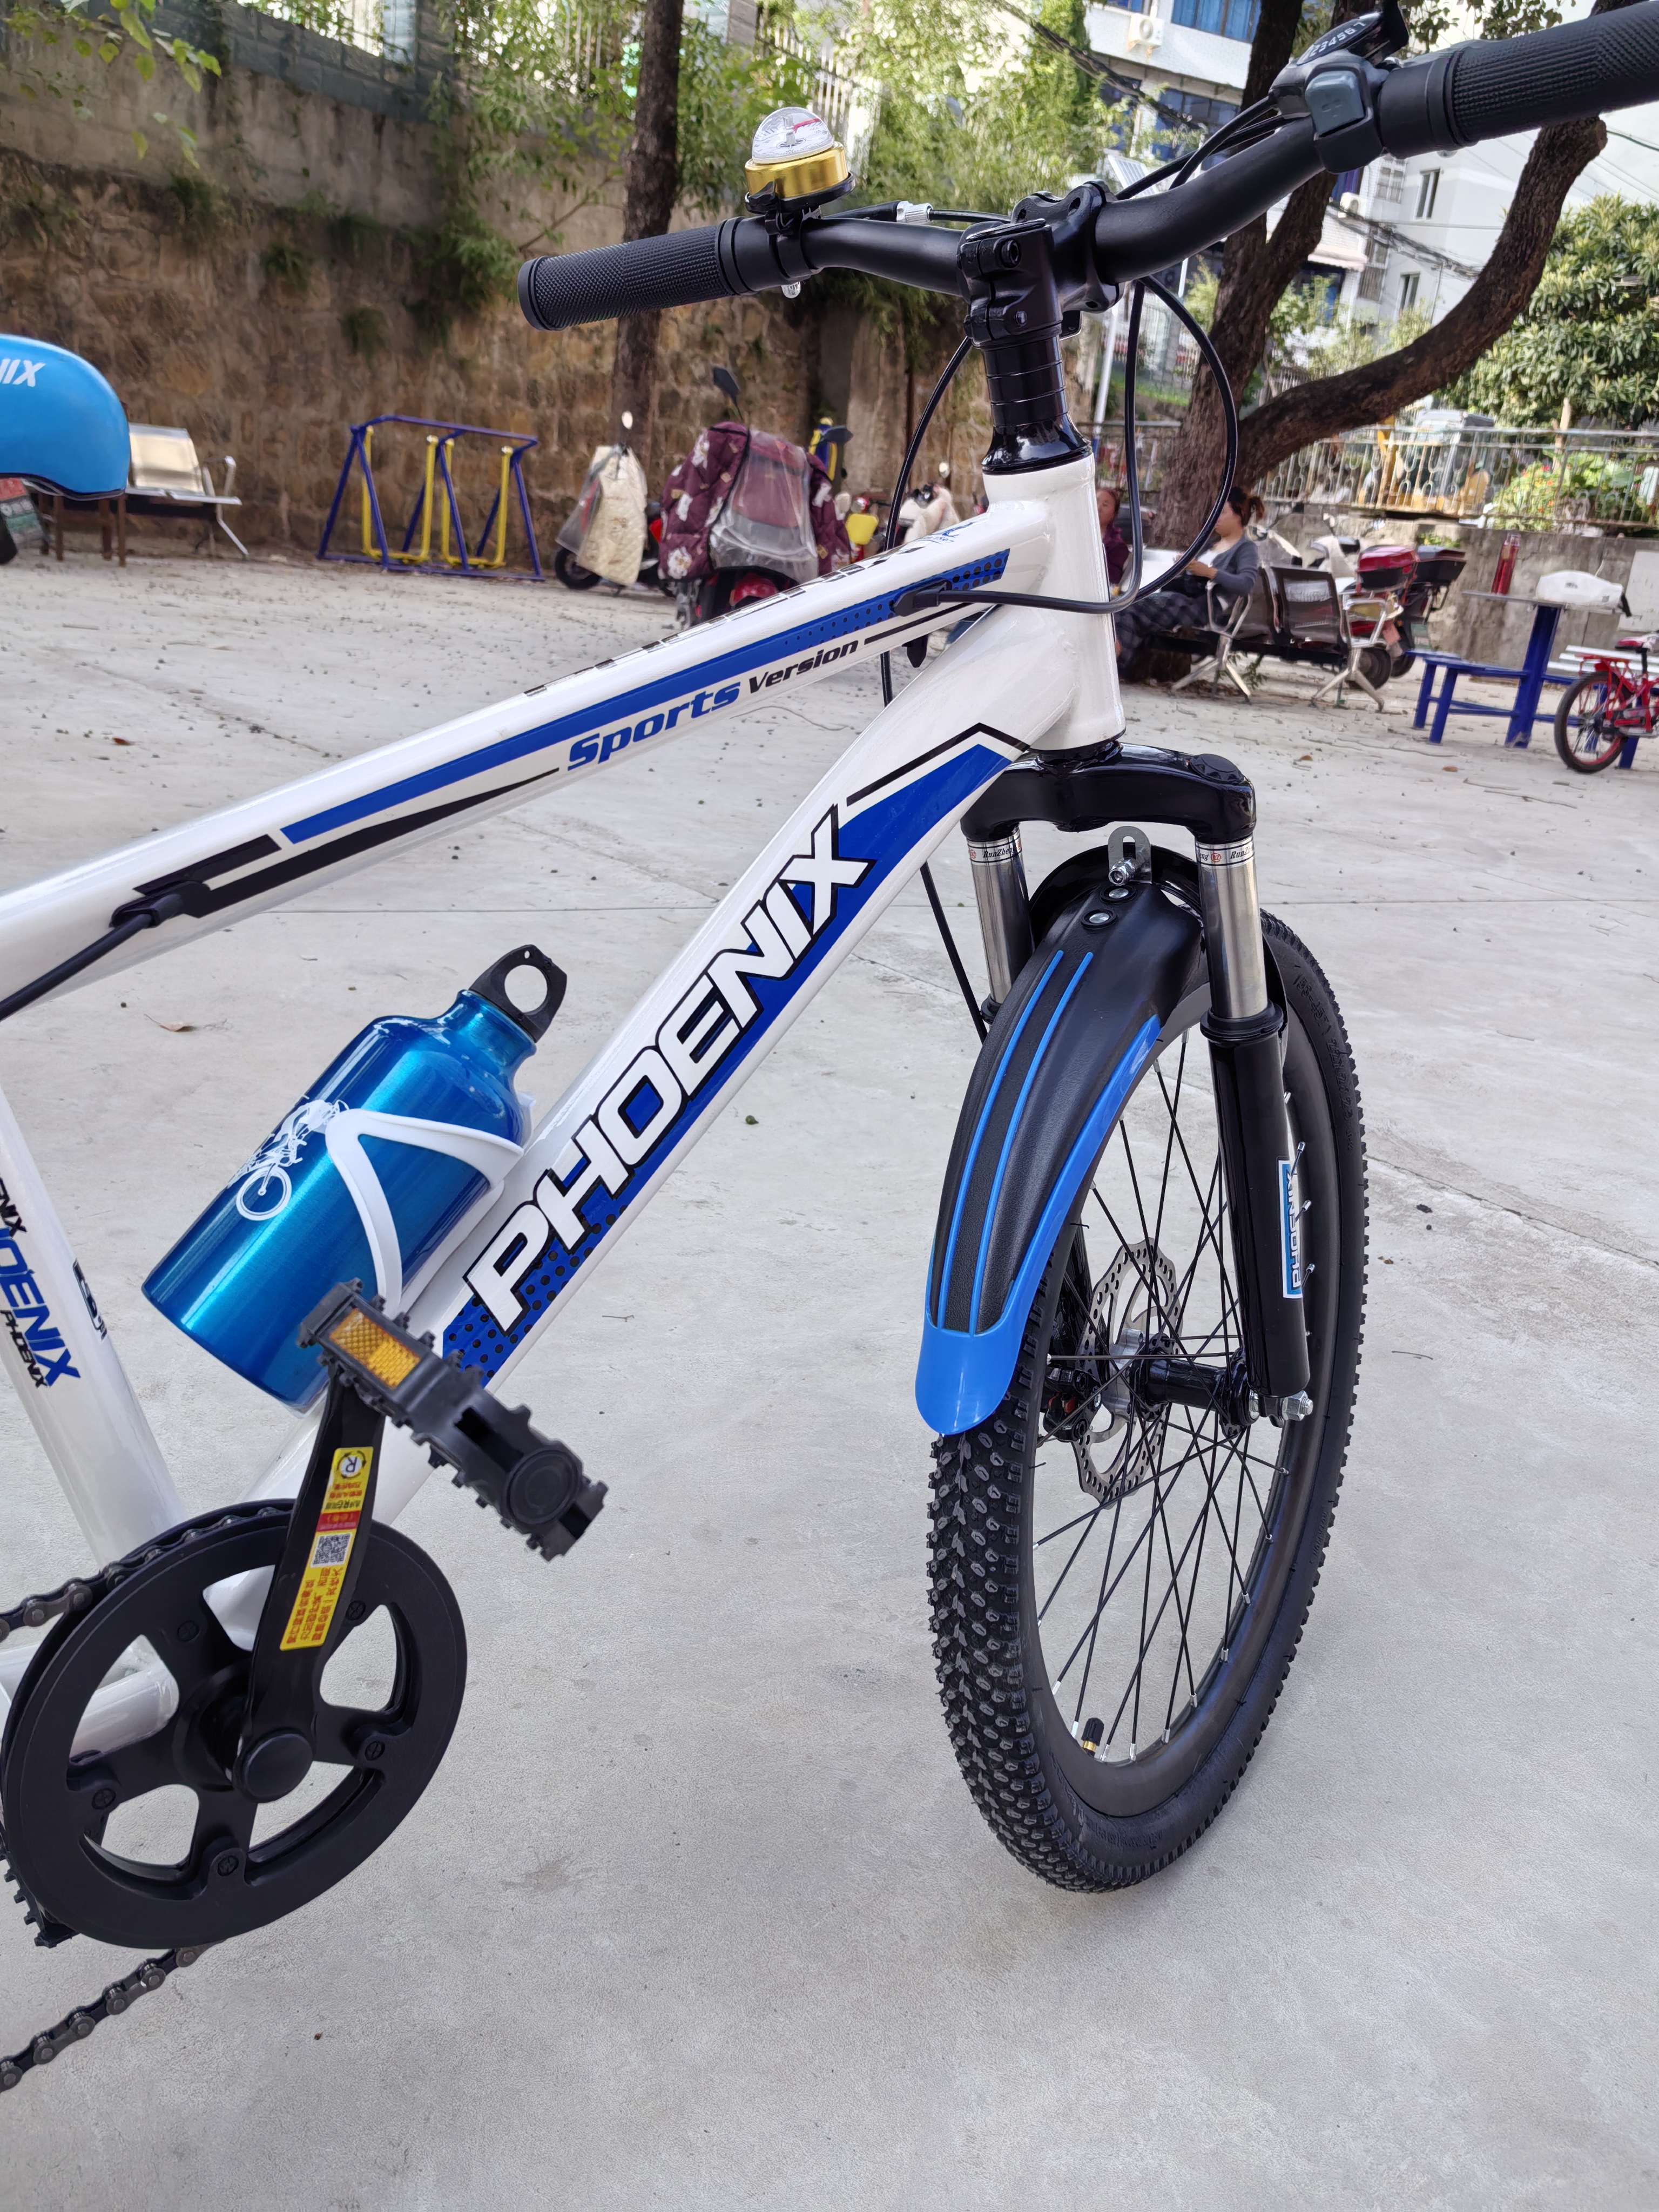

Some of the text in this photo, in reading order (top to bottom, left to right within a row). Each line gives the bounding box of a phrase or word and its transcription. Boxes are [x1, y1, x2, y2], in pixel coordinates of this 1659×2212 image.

[567, 640, 859, 771] Sports Version
[463, 804, 878, 1335] PHOENIX
[1, 1310, 48, 1388] PHOENIX
[345, 1456, 359, 1472] R
